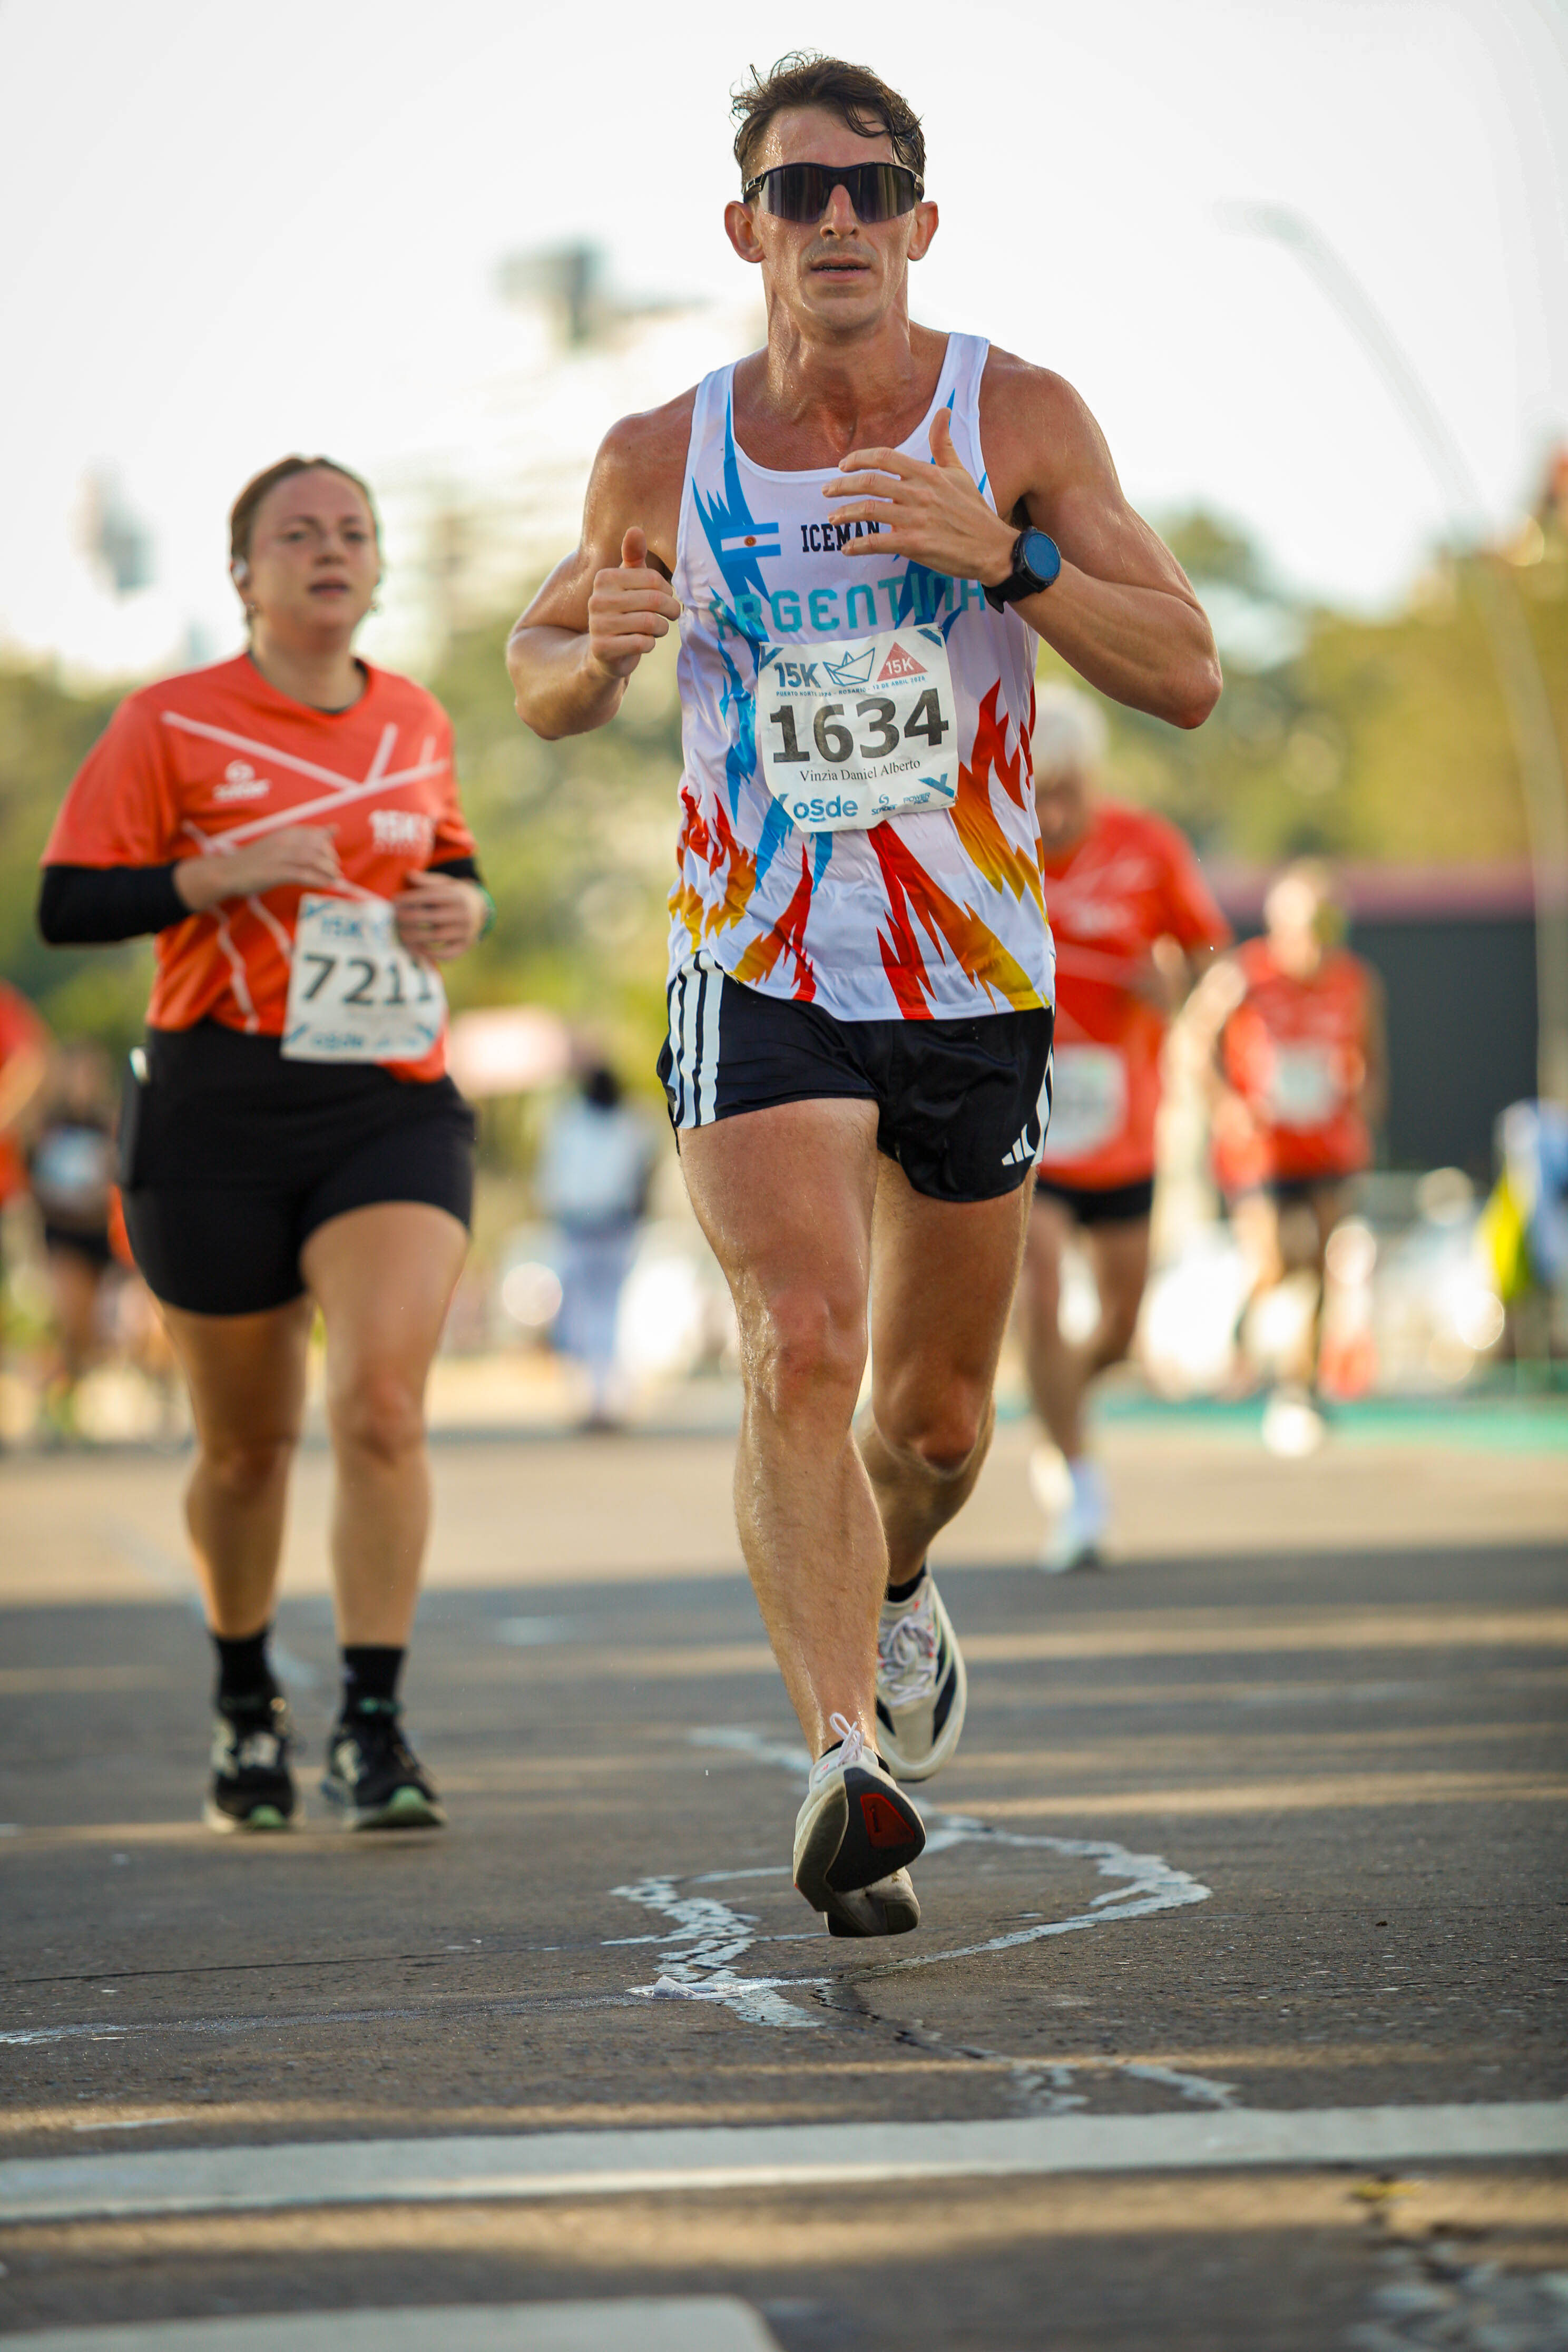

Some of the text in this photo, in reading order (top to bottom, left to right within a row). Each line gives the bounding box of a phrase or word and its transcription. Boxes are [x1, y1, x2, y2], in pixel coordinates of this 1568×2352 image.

[709, 571, 986, 640] ARGENTINA
[774, 662, 821, 688] 15K
[886, 658, 915, 675] 15K
[769, 688, 949, 763] 1634
[800, 759, 920, 781] Vinzia Daniel Alberto
[793, 795, 858, 819] osde
[303, 953, 433, 1006] 7211
